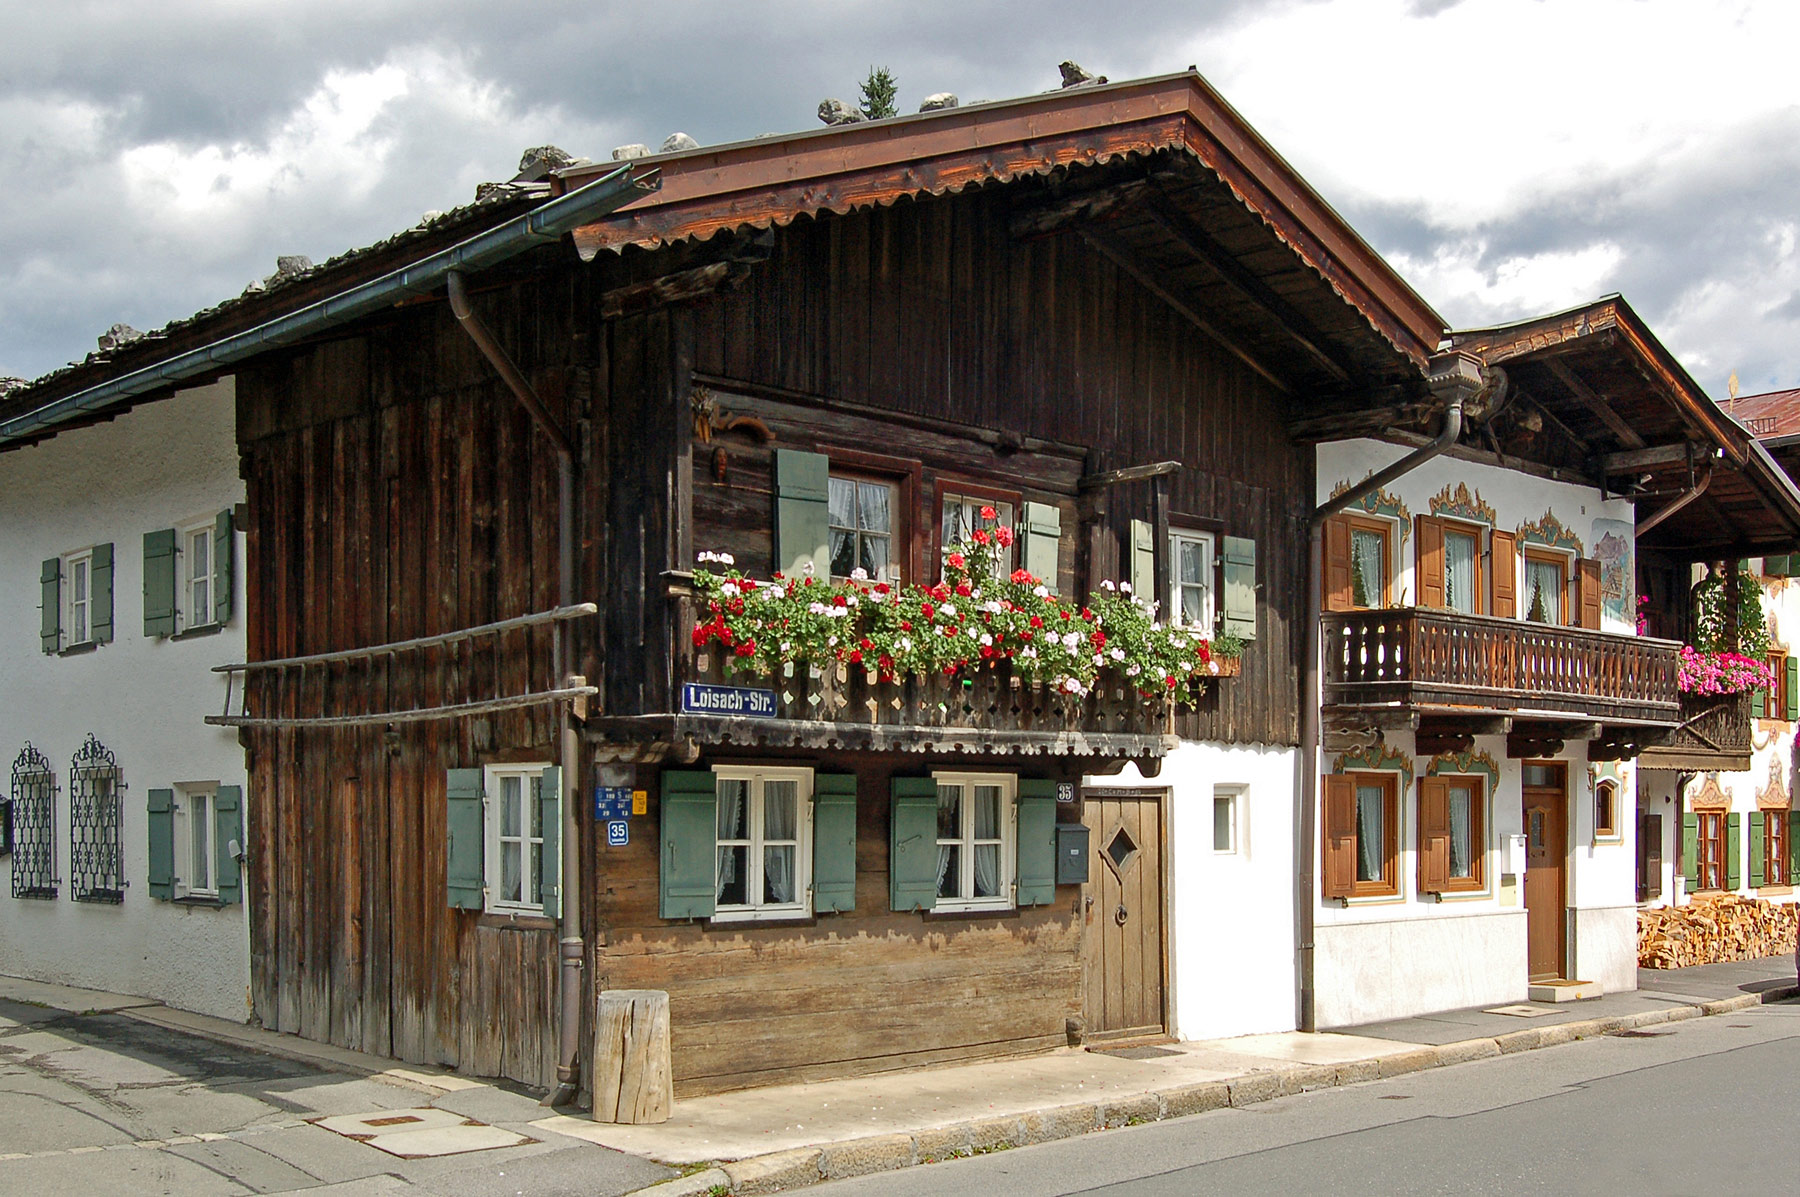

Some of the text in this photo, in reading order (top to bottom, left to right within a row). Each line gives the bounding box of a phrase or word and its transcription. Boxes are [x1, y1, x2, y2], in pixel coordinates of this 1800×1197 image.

[690, 687, 773, 712] Loisach-Str.
[1059, 785, 1071, 800] 35
[611, 825, 625, 837] 35
